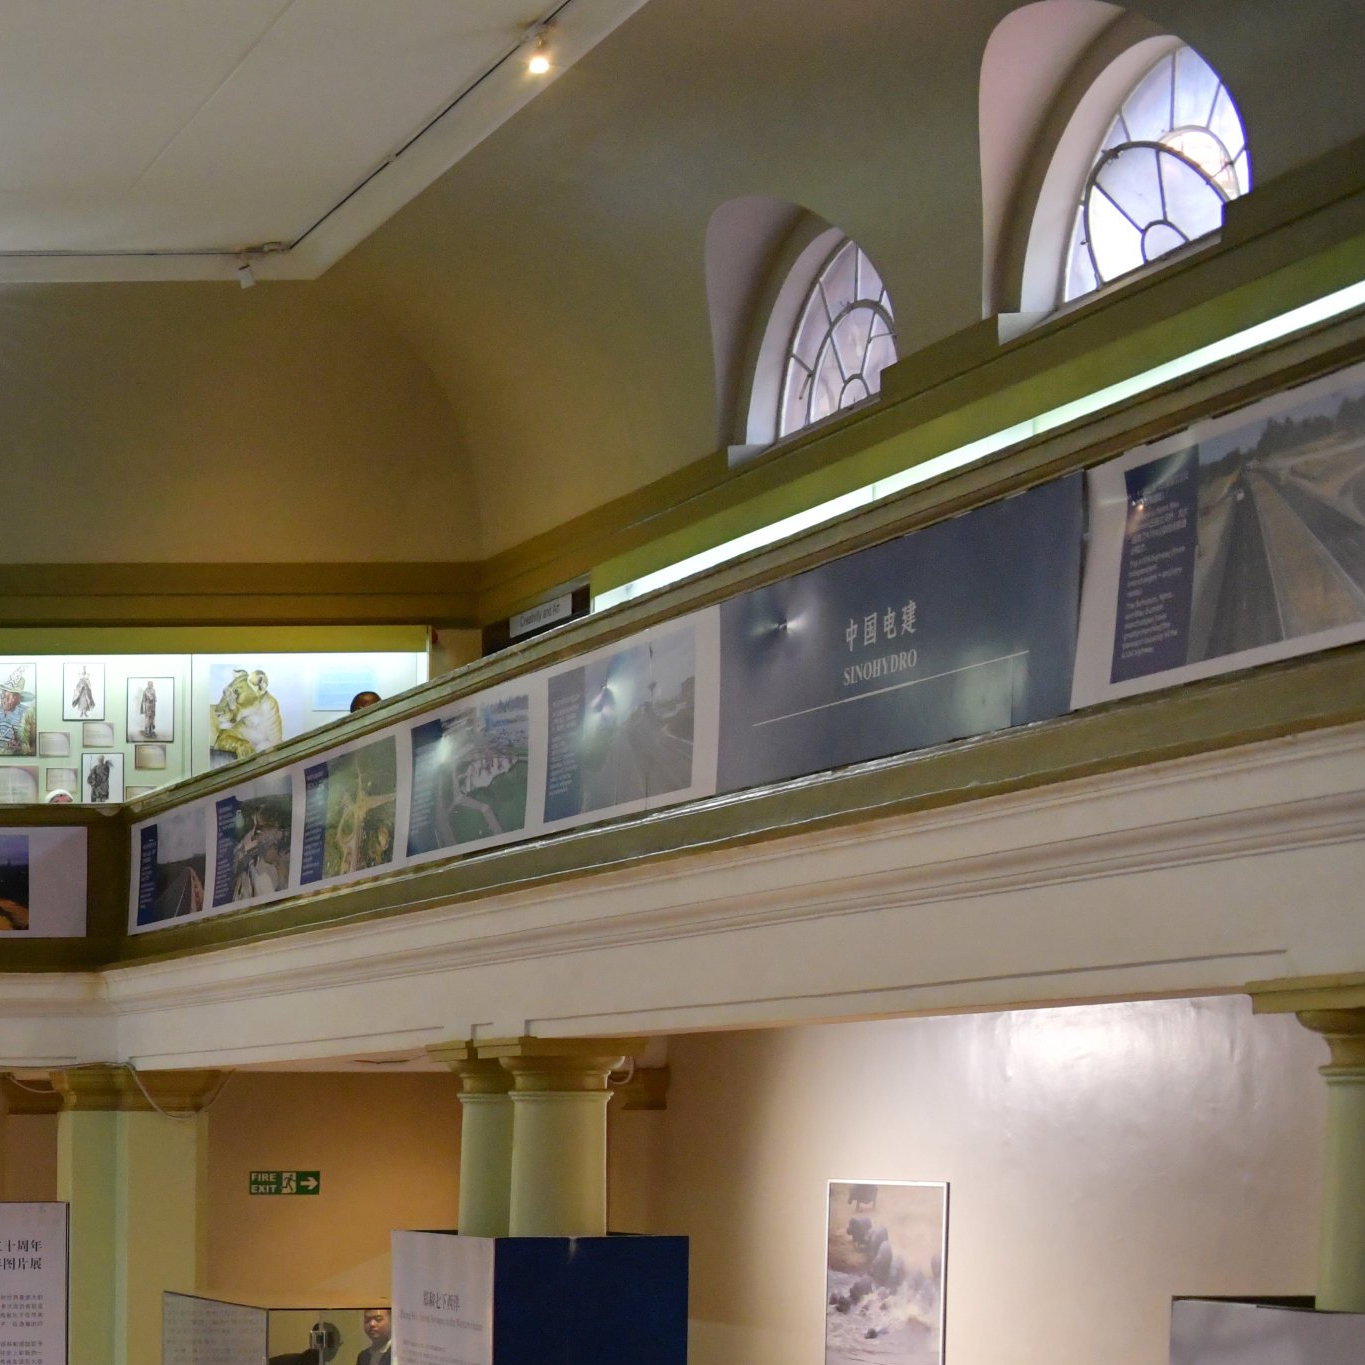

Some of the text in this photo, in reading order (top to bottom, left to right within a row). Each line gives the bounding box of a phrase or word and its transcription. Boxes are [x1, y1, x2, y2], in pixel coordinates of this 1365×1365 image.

[542, 607, 550, 619] and
[845, 599, 916, 652] 中国电建
[843, 648, 917, 685] SINOHYDRO
[251, 1172, 277, 1181] FIRE
[251, 1184, 277, 1192] EXIT
